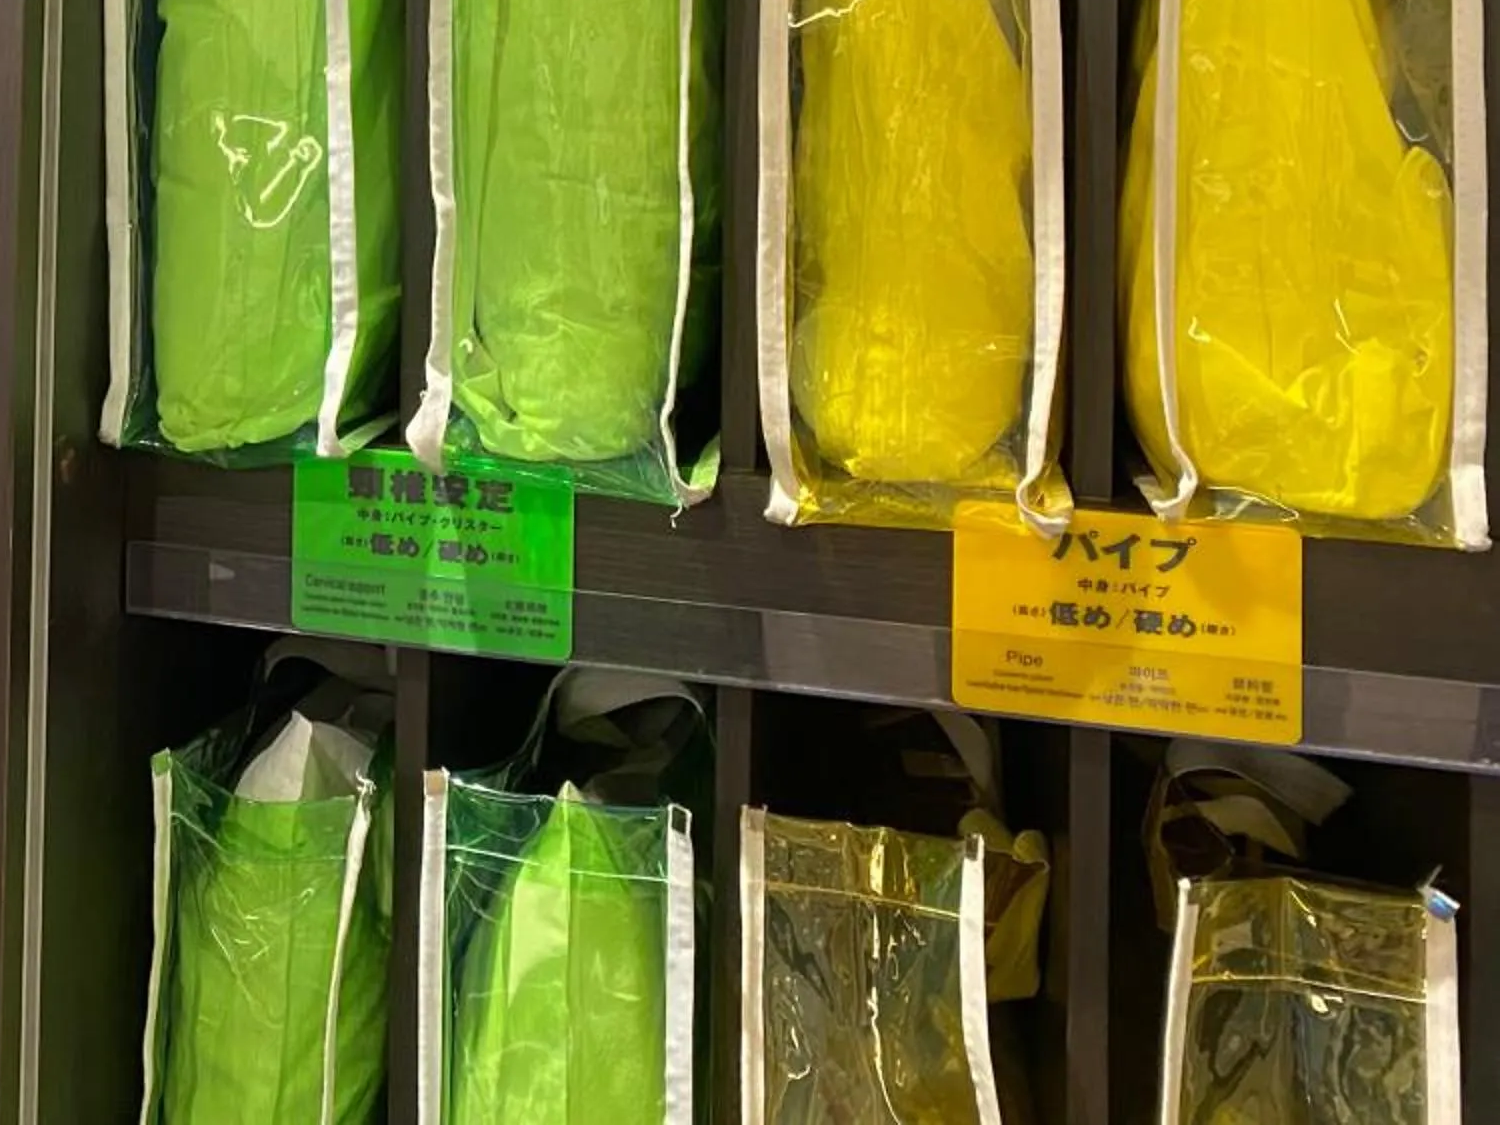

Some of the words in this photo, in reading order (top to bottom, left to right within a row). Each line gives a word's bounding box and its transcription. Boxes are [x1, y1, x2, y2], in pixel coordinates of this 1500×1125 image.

[1051, 530, 1197, 573] パイプ
[1006, 650, 1044, 668] Pipe
